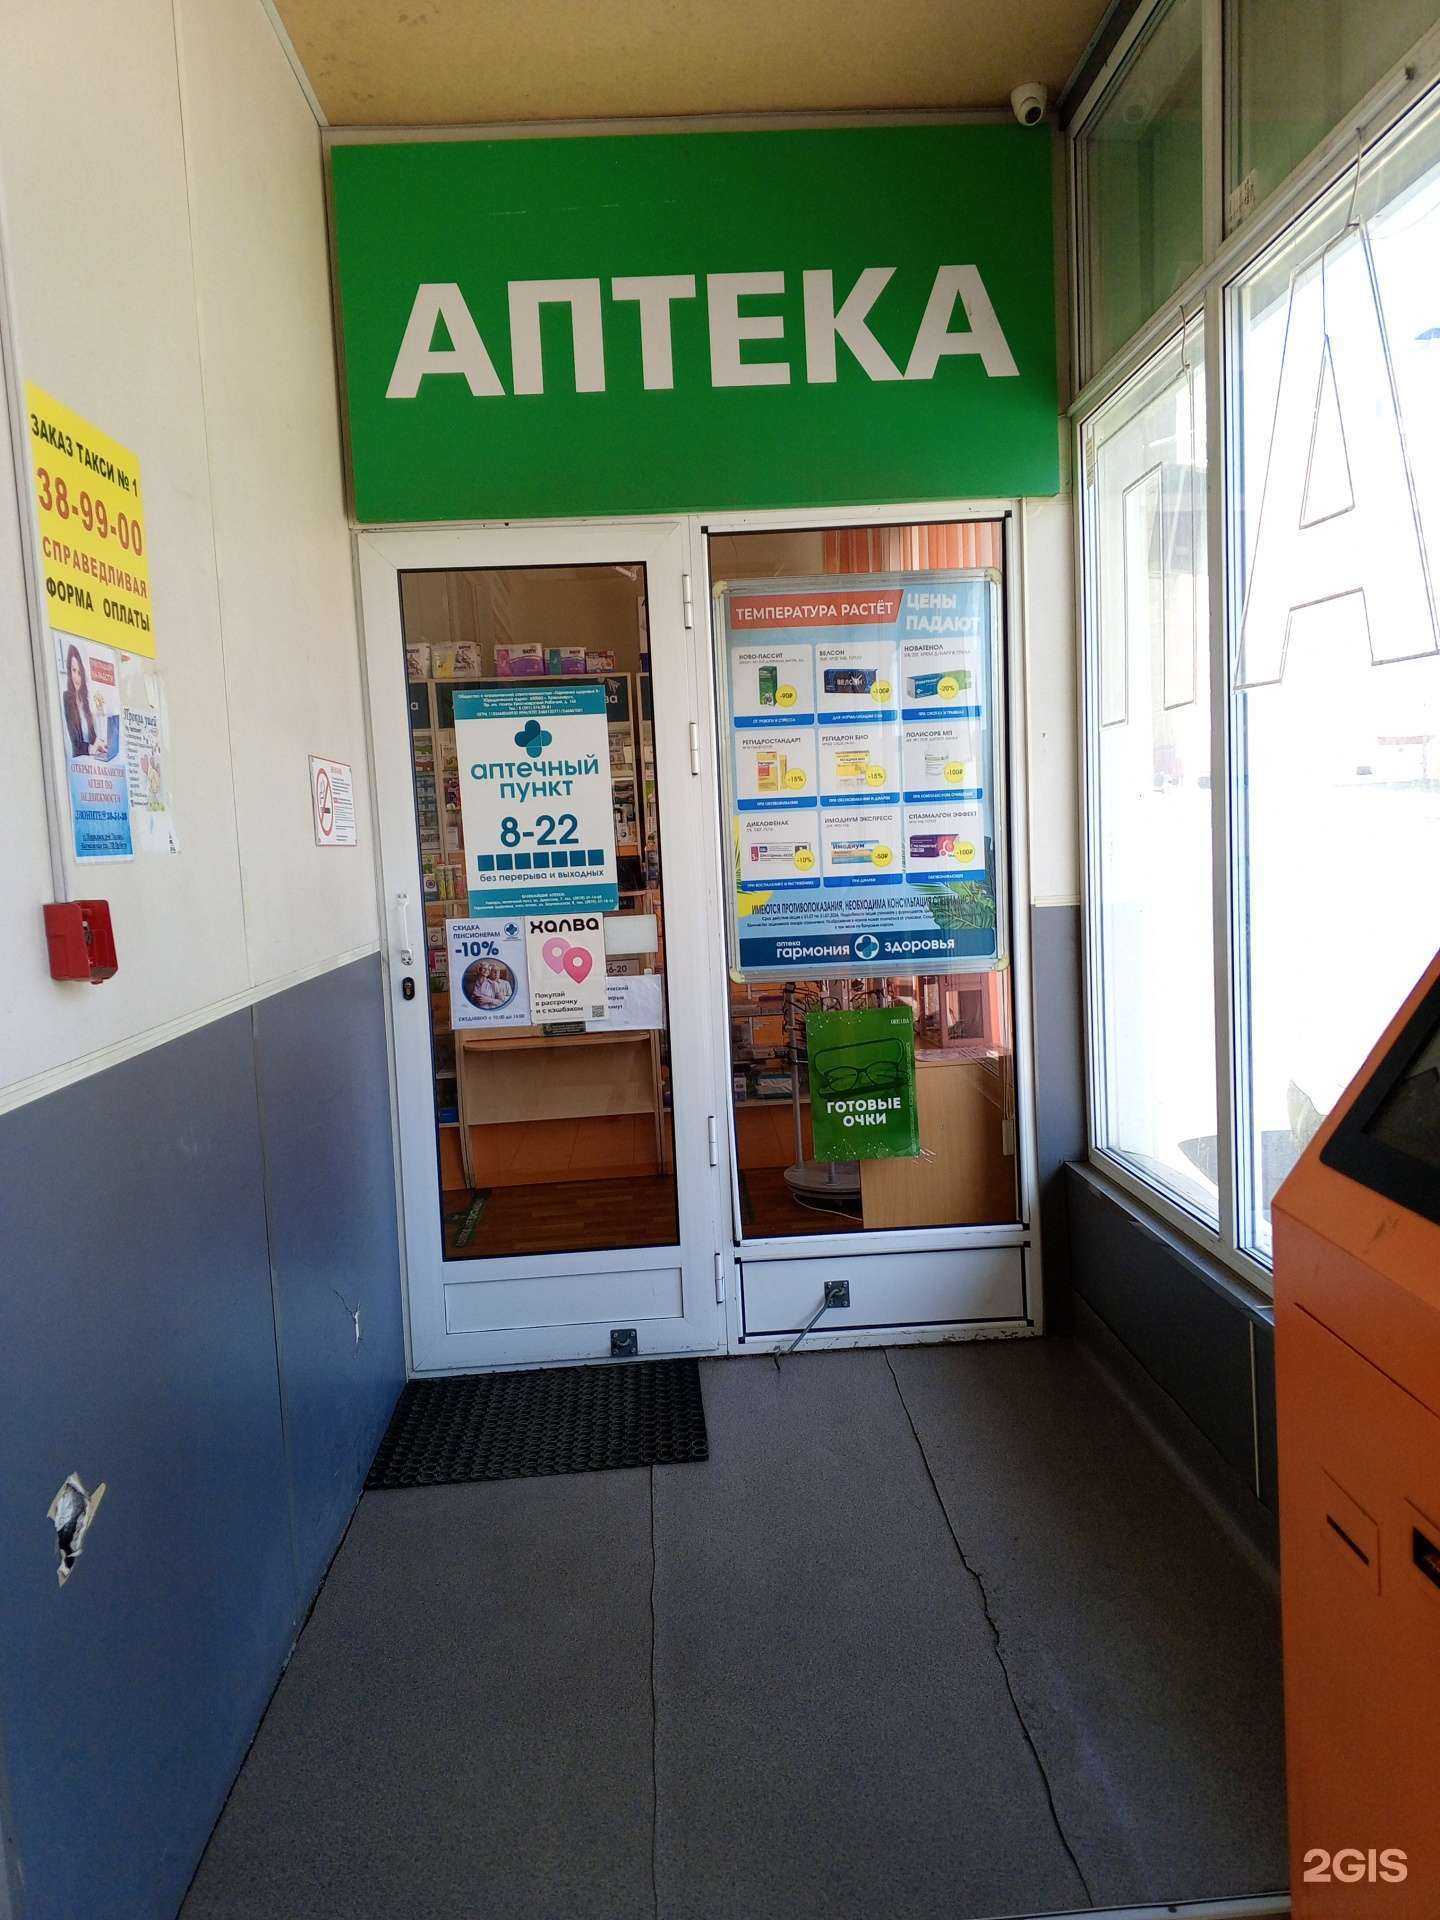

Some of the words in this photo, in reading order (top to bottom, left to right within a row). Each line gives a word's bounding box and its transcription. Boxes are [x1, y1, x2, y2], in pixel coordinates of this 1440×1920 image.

[385, 264, 1020, 399] АПТЕКА
[31, 414, 73, 457] ЗАКАЗ
[76, 442, 115, 482] ТАКСИ
[132, 479, 138, 497] 1
[37, 467, 142, 556] 38-99-00
[42, 536, 148, 598] СПРАВЕДЛИВАЯ
[46, 577, 94, 611] ФОРМА
[103, 598, 151, 632] ОПЛАТЫ
[736, 603, 836, 621] ТЕМПЕРАТУРА
[841, 600, 893, 616] РАСТЁТ
[907, 592, 957, 610] ЦЕНЫ
[906, 616, 981, 633] ПАДАЮТ
[471, 754, 599, 780] аптечный
[500, 780, 573, 803] пункт
[500, 814, 579, 848] 8-22
[480, 873, 496, 882] без
[499, 872, 547, 882] перерыва
[558, 869, 604, 879] выходных
[752, 904, 780, 915] ИМЕЮТСЯ
[782, 900, 845, 913] ПРОТИВОПОКАЗАНИЯ,
[846, 897, 885, 910] НЕОБХОДИМА
[453, 931, 500, 939] ПЕНСИОНЕРАМ
[455, 941, 499, 957] -10%
[776, 945, 850, 960] гармония
[885, 939, 955, 953] здоровья
[535, 990, 566, 999] Покупай
[541, 999, 578, 1007] рассрочку
[827, 1097, 901, 1114] ГОТОВЫЕ
[843, 1115, 887, 1128] ОЧКИ
